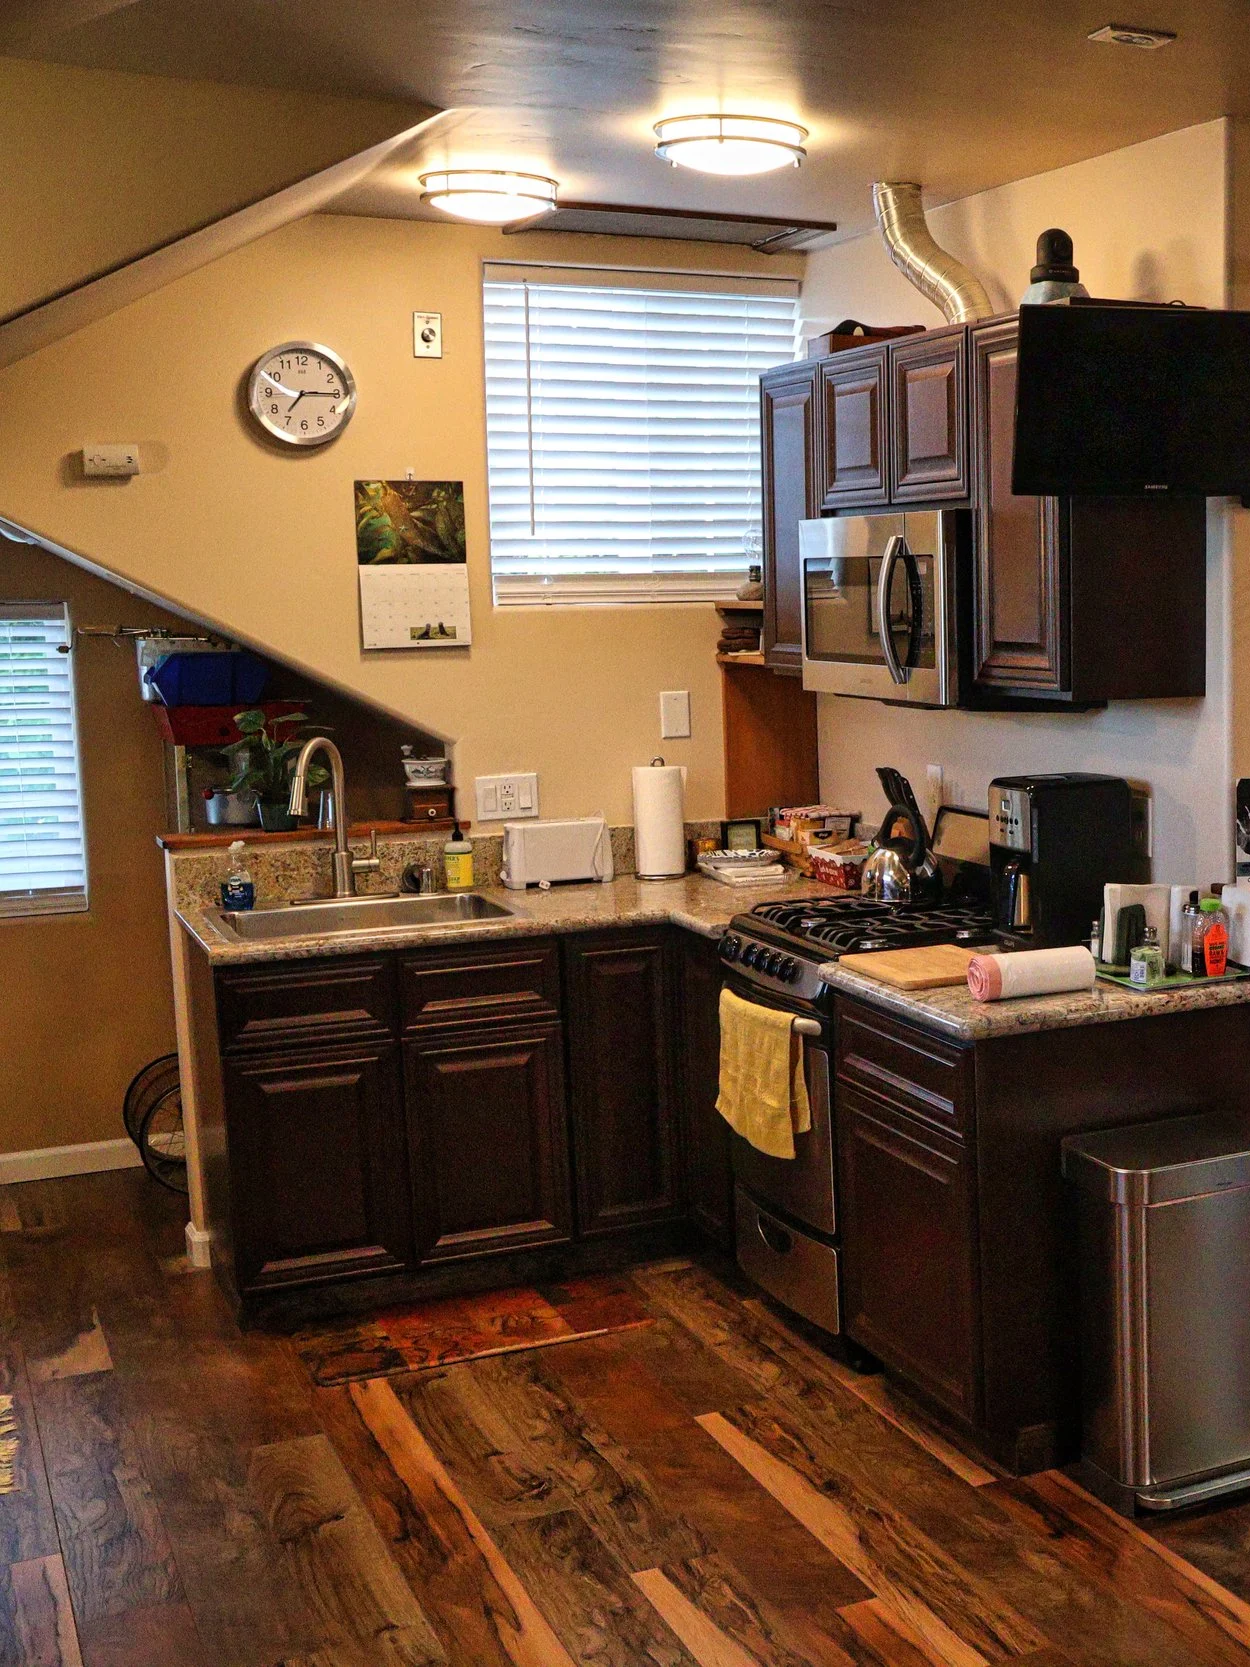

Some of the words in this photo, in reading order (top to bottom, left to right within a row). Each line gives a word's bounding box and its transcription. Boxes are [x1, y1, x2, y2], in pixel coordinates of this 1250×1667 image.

[279, 360, 291, 370] 11
[294, 355, 309, 366] 12
[317, 361, 322, 370] 1
[268, 371, 281, 382] 10
[326, 373, 334, 384] 2
[264, 387, 273, 397] 9
[333, 389, 340, 399] 3
[270, 403, 279, 414] 8
[329, 405, 336, 413] 4
[284, 416, 292, 425] 7
[300, 420, 309, 430] 6
[316, 416, 325, 426] 5
